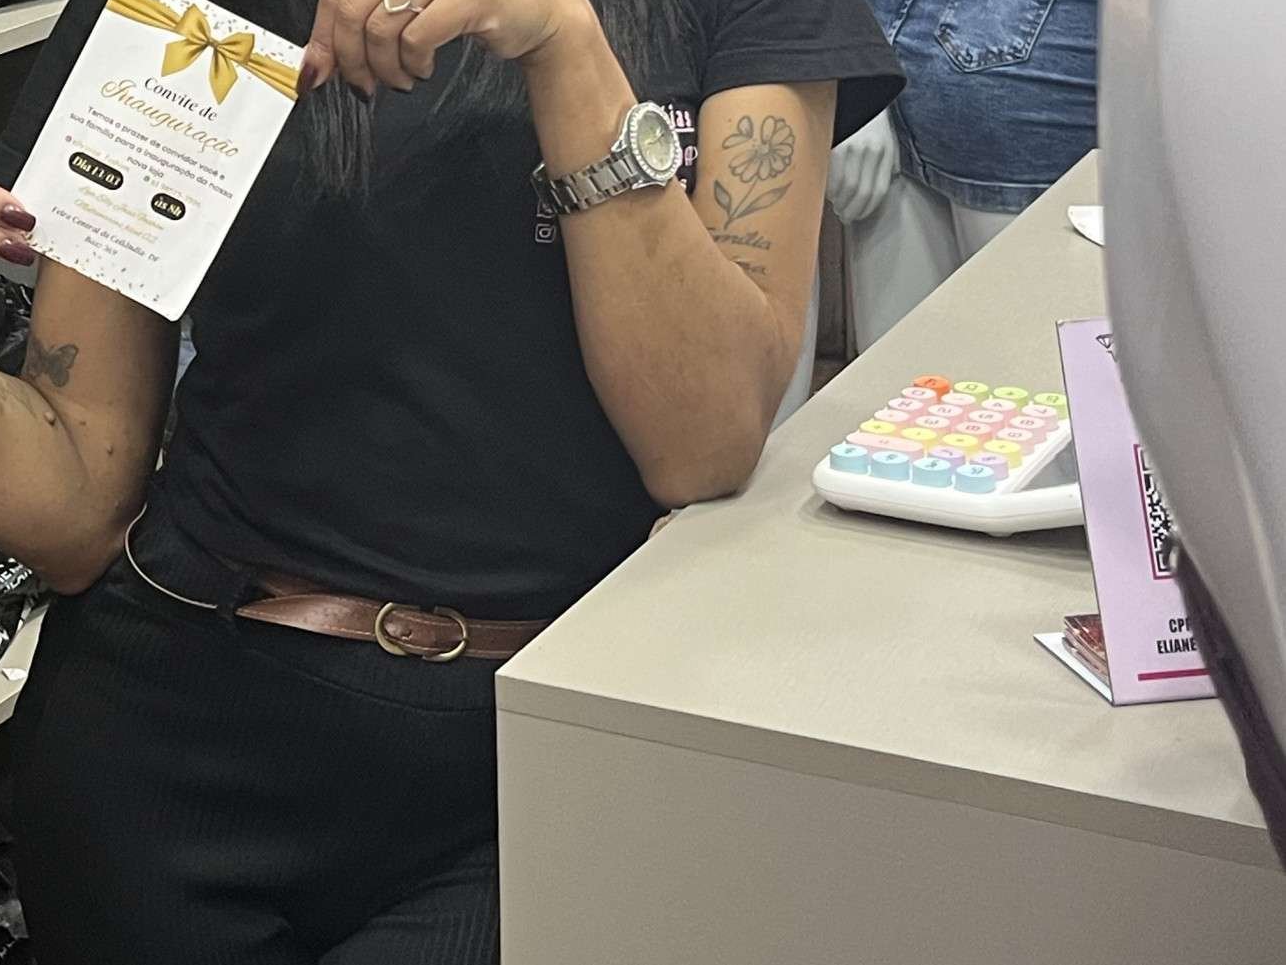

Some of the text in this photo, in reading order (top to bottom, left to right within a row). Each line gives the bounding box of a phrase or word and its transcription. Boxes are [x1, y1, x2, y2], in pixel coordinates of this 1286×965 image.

[99, 78, 239, 156] Inauguração
[144, 77, 217, 121] Convite de
[69, 112, 84, 124] sua
[113, 135, 135, 150] para
[195, 176, 208, 185] da
[208, 182, 233, 199] nossa
[87, 105, 114, 124] Temos
[120, 125, 148, 141] prazer
[149, 139, 161, 148] de
[161, 145, 198, 166] convidar
[126, 156, 164, 178] nova loja
[71, 215, 101, 234] Central
[1156, 638, 1198, 654] ELIANE
